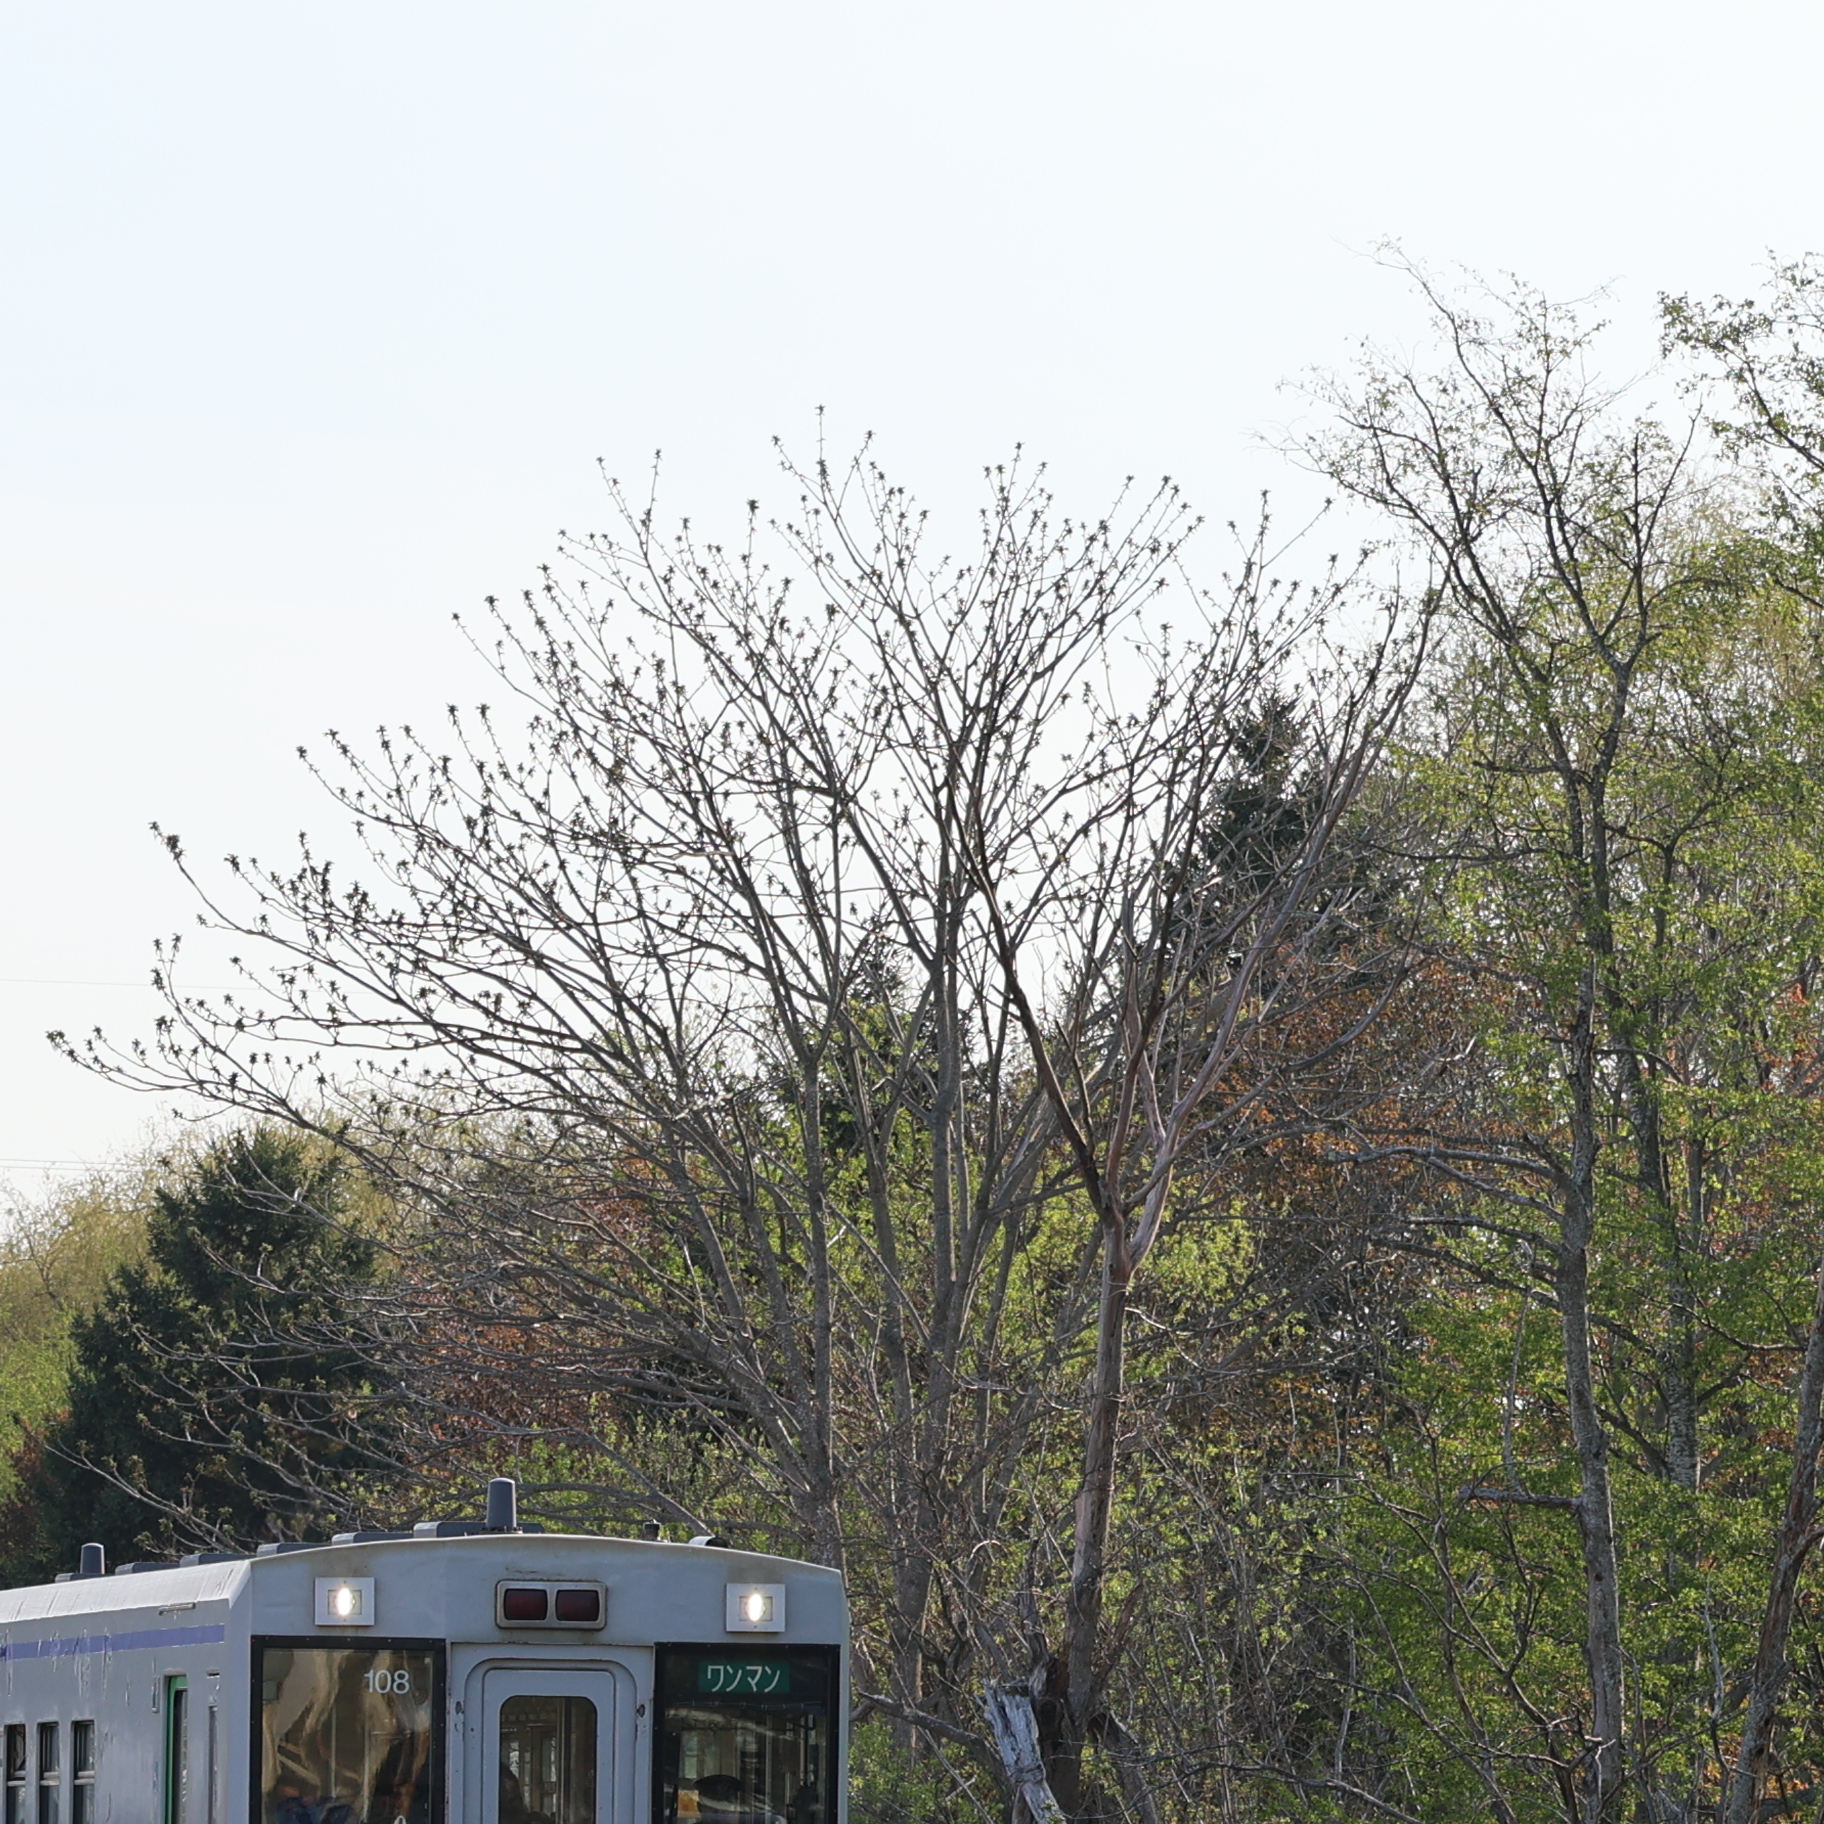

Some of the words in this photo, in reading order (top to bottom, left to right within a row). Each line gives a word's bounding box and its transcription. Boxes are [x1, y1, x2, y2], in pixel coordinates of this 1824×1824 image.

[363, 1669, 411, 1694] 108
[706, 1664, 781, 1693] ワンマン
